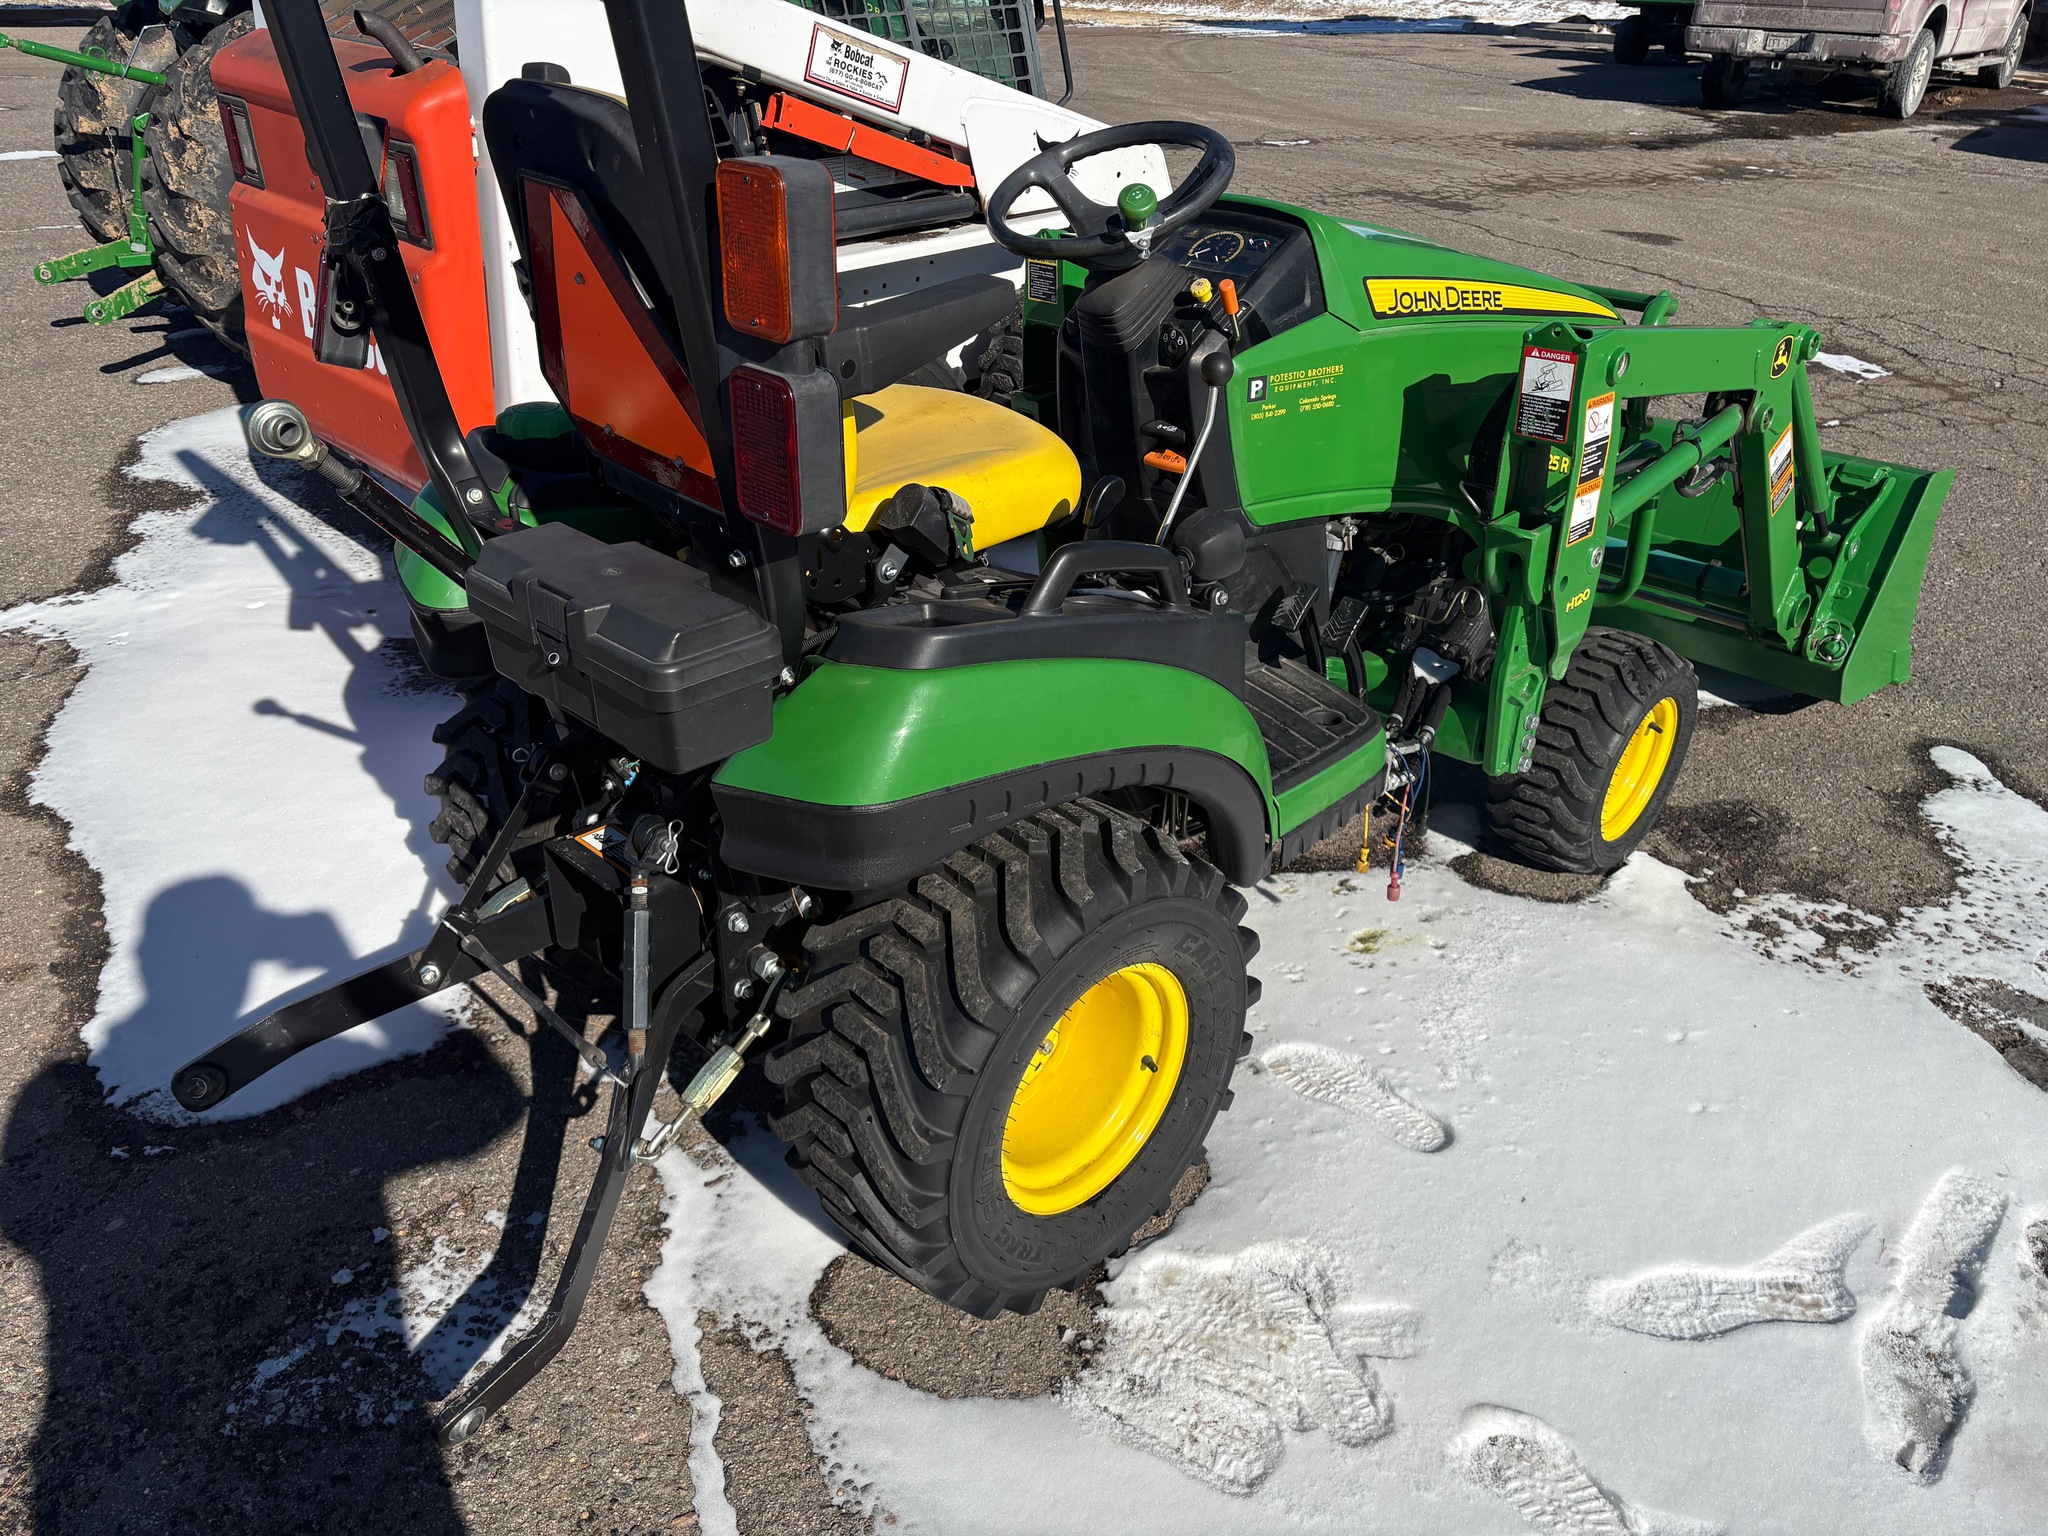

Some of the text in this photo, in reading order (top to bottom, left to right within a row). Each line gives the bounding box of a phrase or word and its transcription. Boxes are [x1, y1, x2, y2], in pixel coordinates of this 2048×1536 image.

[844, 45, 874, 68] Bobcat
[834, 59, 873, 80] ROCKIES
[1388, 287, 1503, 311] JOHN DEERE
[1541, 351, 1570, 361] DANGER
[1270, 364, 1343, 382] POTESTIO BROTHERS
[1275, 381, 1318, 392] EQUIPMENT,
[1299, 396, 1319, 404] Colorado
[1591, 394, 1613, 407] WARNING
[1581, 483, 1600, 495] WARNING
[1566, 588, 1590, 613] H120
